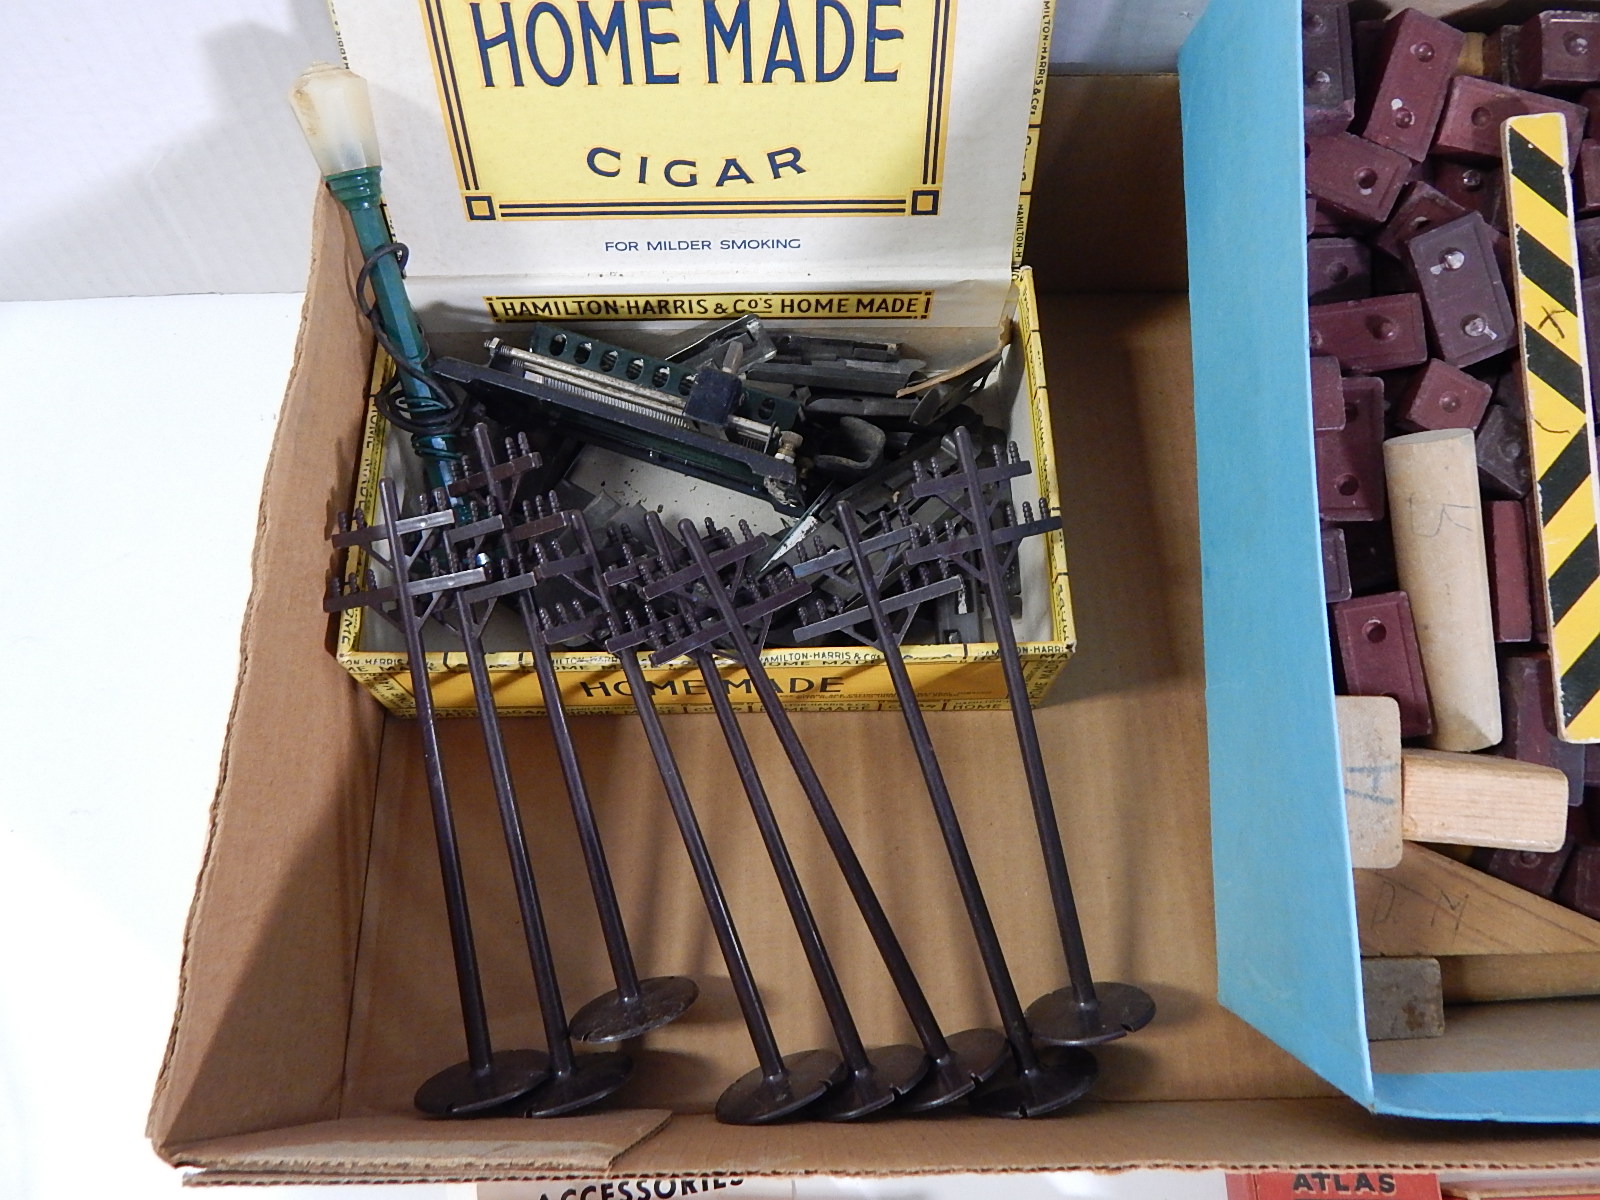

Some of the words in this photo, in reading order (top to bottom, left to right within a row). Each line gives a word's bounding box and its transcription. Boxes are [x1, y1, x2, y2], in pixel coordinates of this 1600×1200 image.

[469, 0, 681, 88] HOME
[703, 0, 905, 84] MADE
[586, 146, 807, 189] CIGAR
[605, 241, 640, 252] FOR
[646, 240, 713, 251] MILDER
[719, 238, 802, 250] SMOKING
[501, 298, 709, 317] HAMILTON-HARRIS
[713, 302, 729, 315] &
[780, 298, 850, 314] HOME
[855, 297, 919, 313] MADE
[1293, 1172, 1397, 1194] ATLAS
